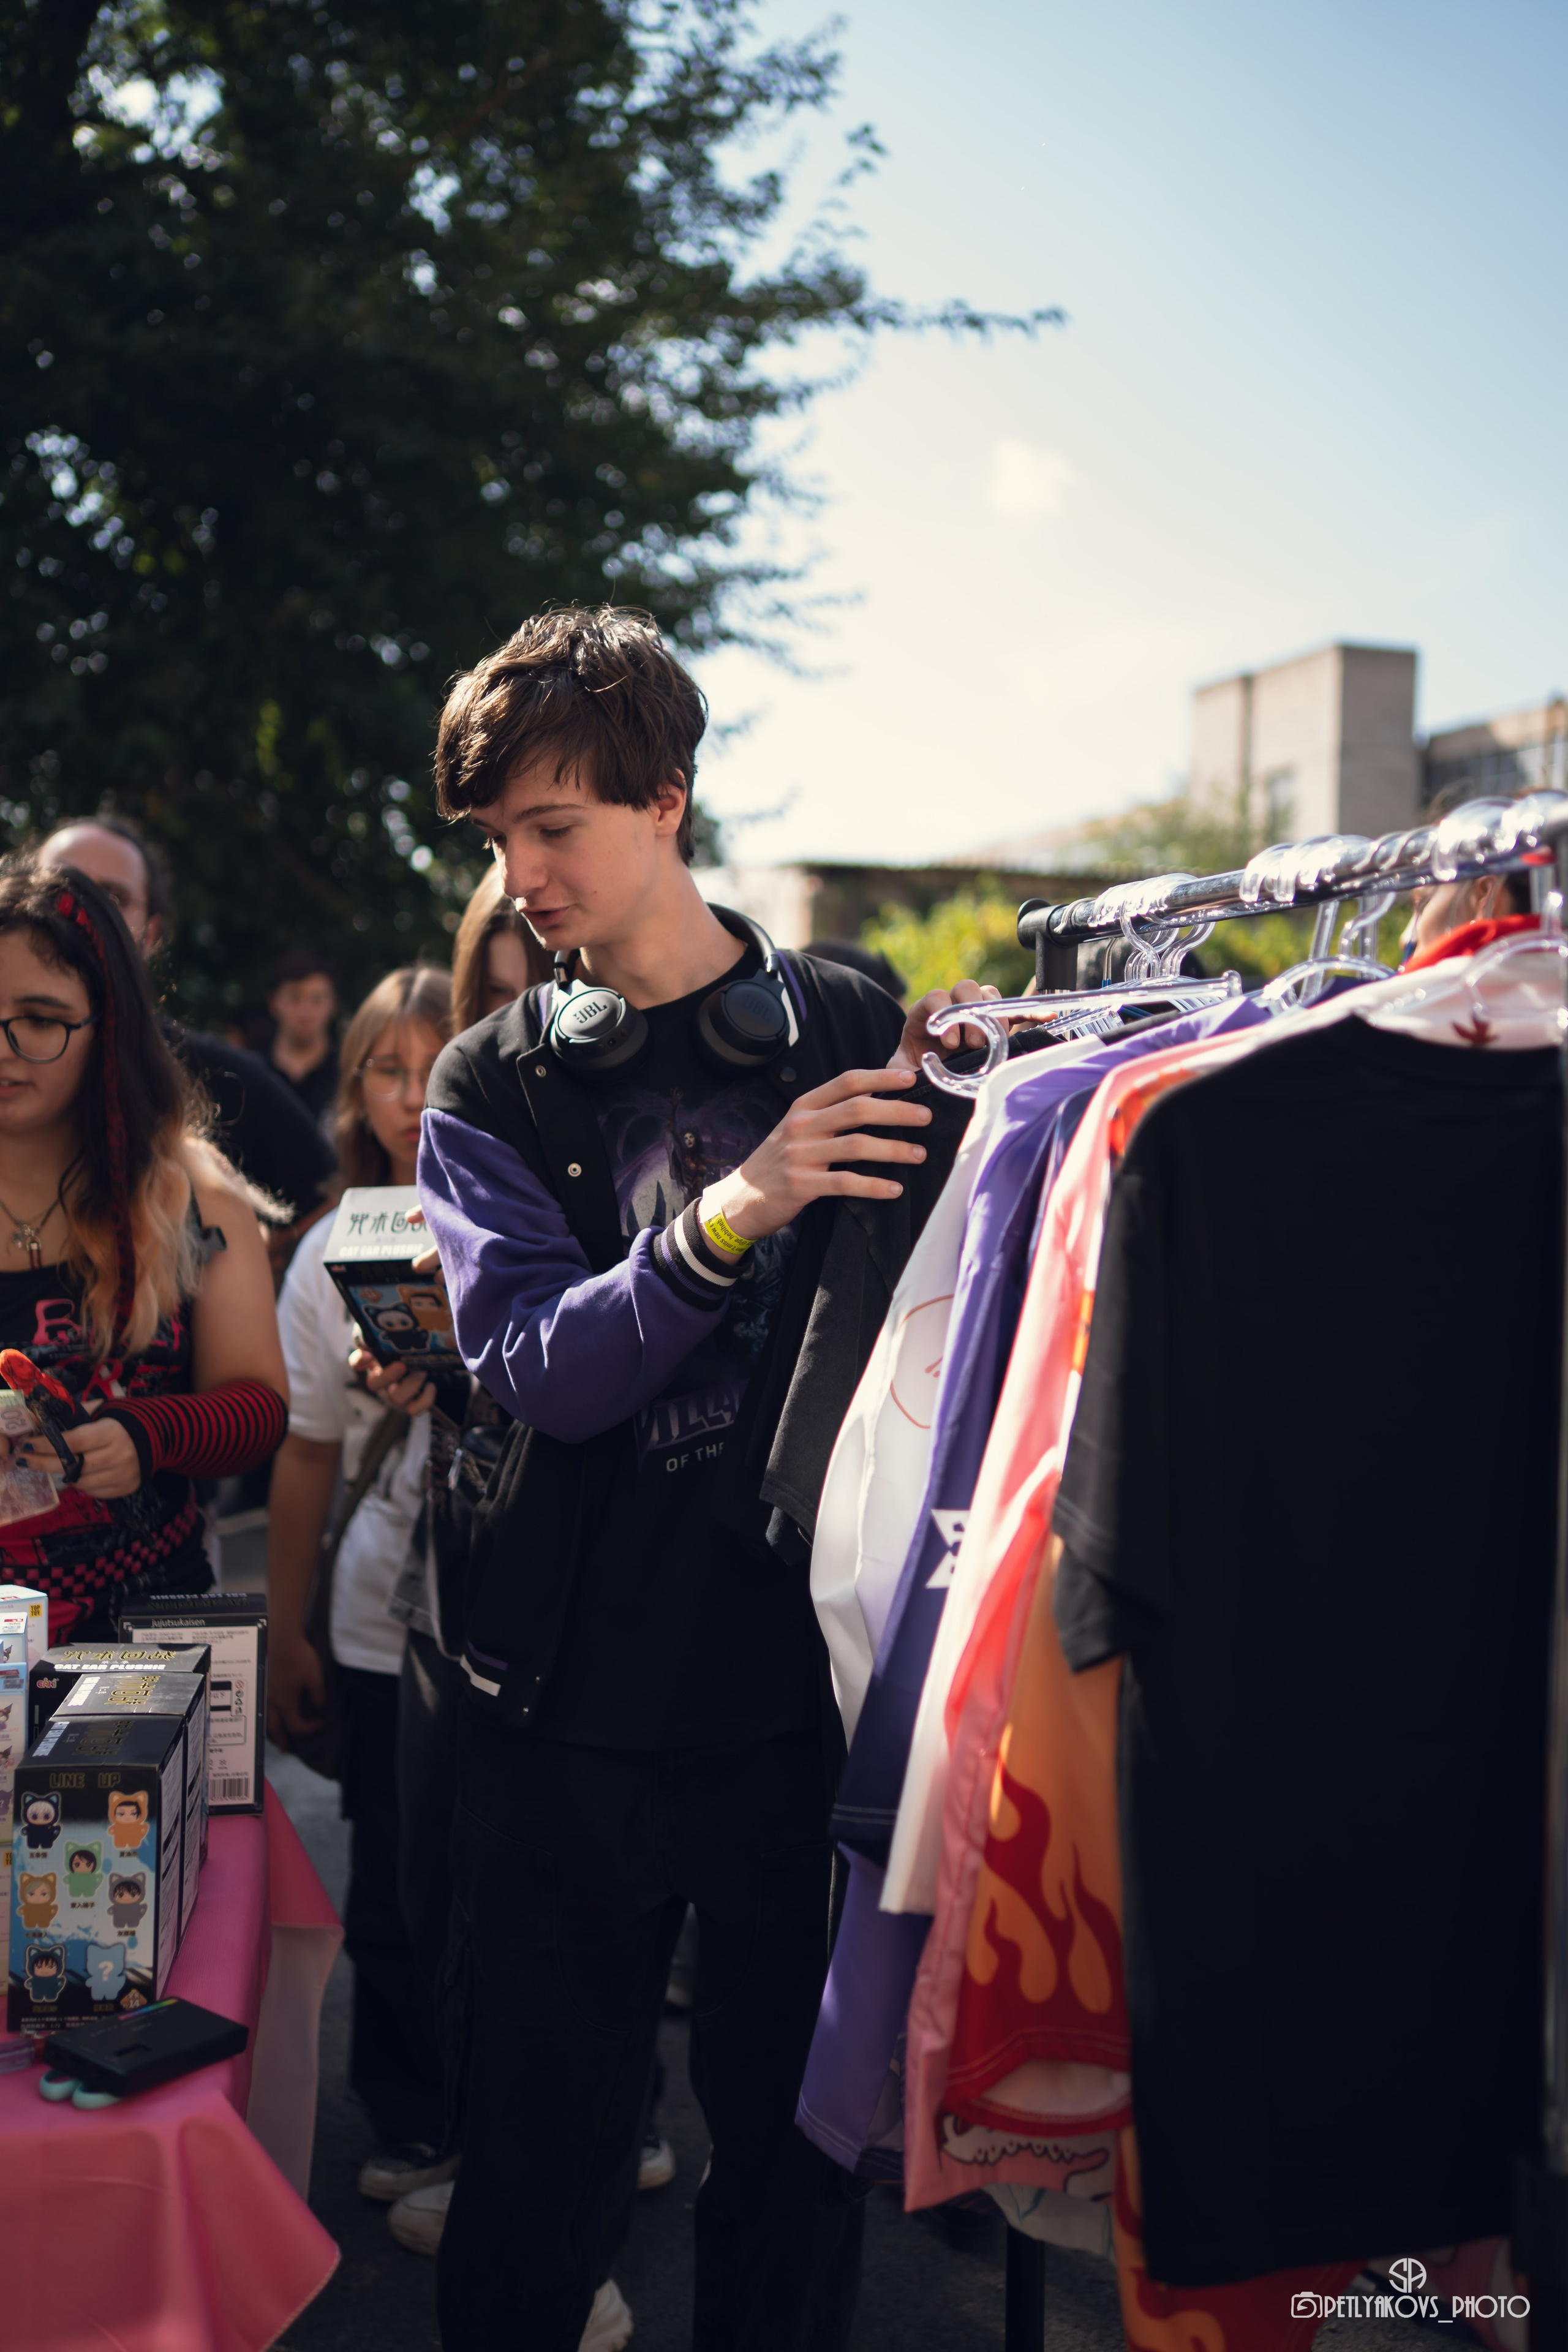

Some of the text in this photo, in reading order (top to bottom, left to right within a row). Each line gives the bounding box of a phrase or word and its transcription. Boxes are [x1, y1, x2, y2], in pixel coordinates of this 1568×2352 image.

[575, 1001, 608, 1023] JBL
[742, 993, 772, 1023] JBL
[711, 1227, 722, 1240] new
[720, 1238, 733, 1249] miss
[665, 1453, 690, 1473] OF
[151, 1618, 206, 1628] jujutsukaisen
[49, 1771, 122, 1789] LINE UP
